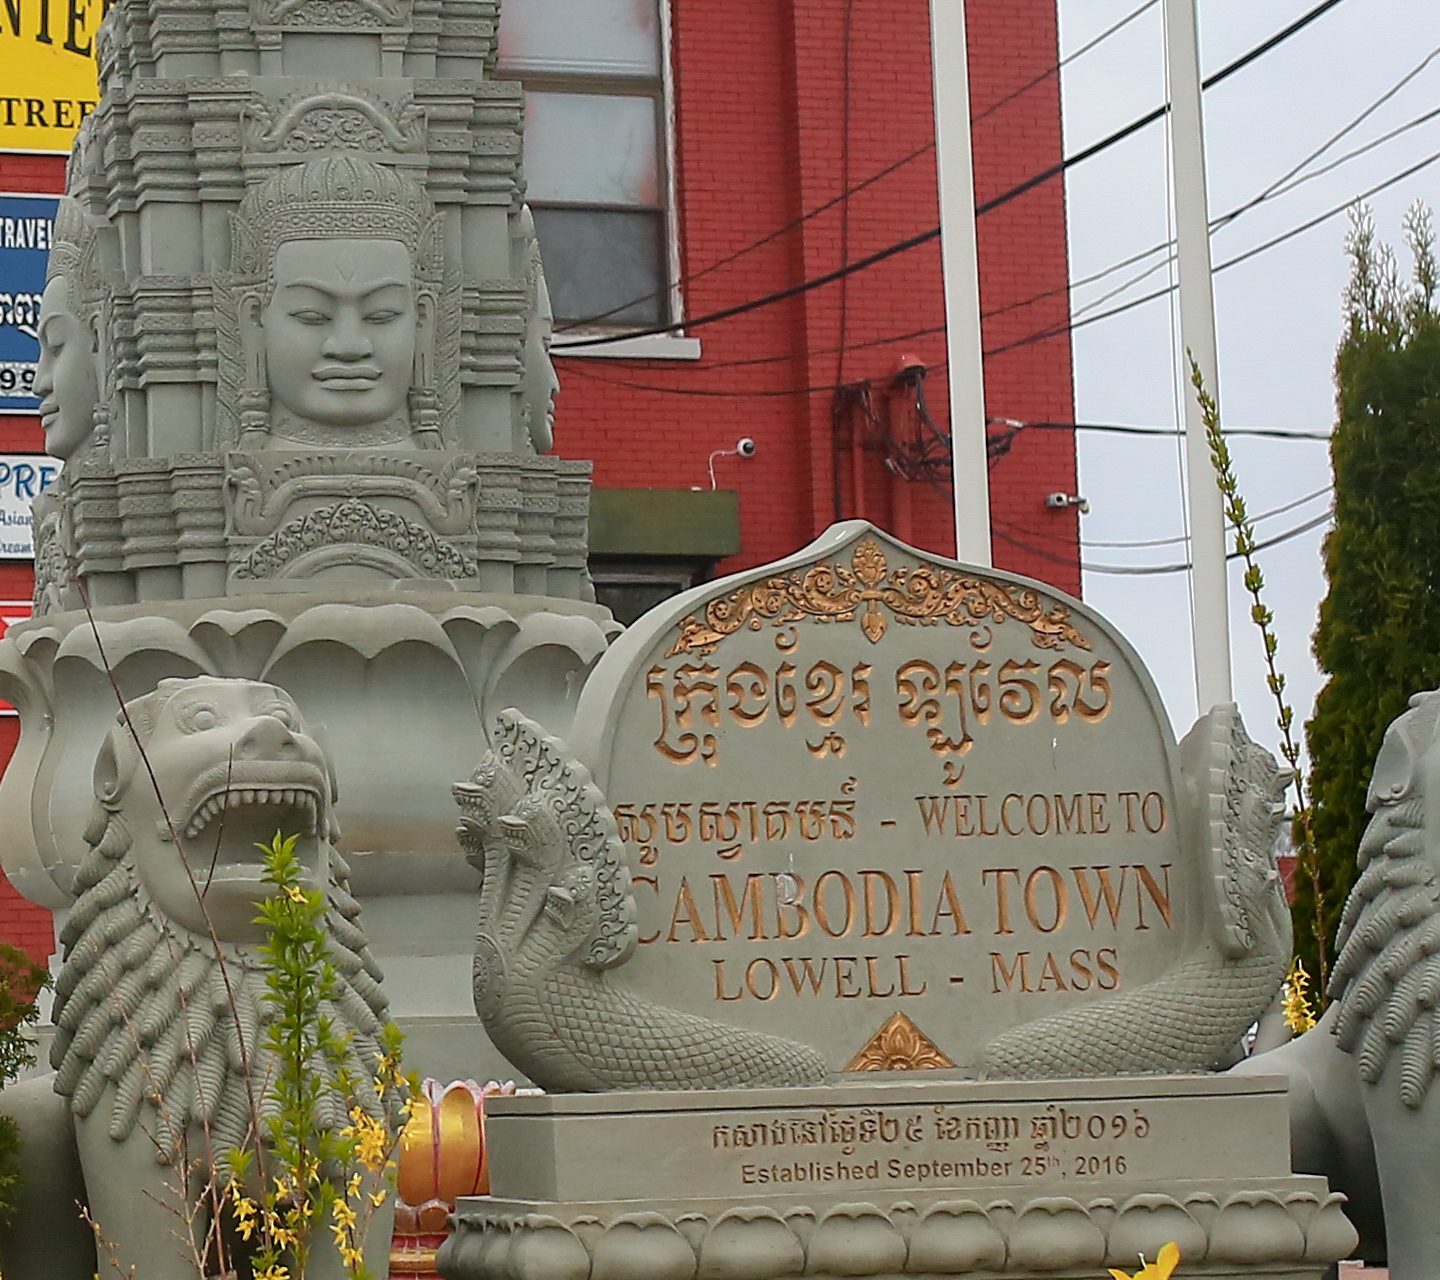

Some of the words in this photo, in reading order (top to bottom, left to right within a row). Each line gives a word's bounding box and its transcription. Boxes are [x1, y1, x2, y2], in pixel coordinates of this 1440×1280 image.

[915, 792, 1111, 838] WELCOME
[1118, 791, 1167, 835] TO
[631, 868, 973, 945] CAMBODIA
[982, 863, 1173, 935] TOWN
[713, 955, 927, 1002] LOWELL
[990, 948, 1120, 994] MASS
[741, 1160, 878, 1184] Established
[887, 1157, 1012, 1182] September
[1075, 1155, 1127, 1175] 2016
